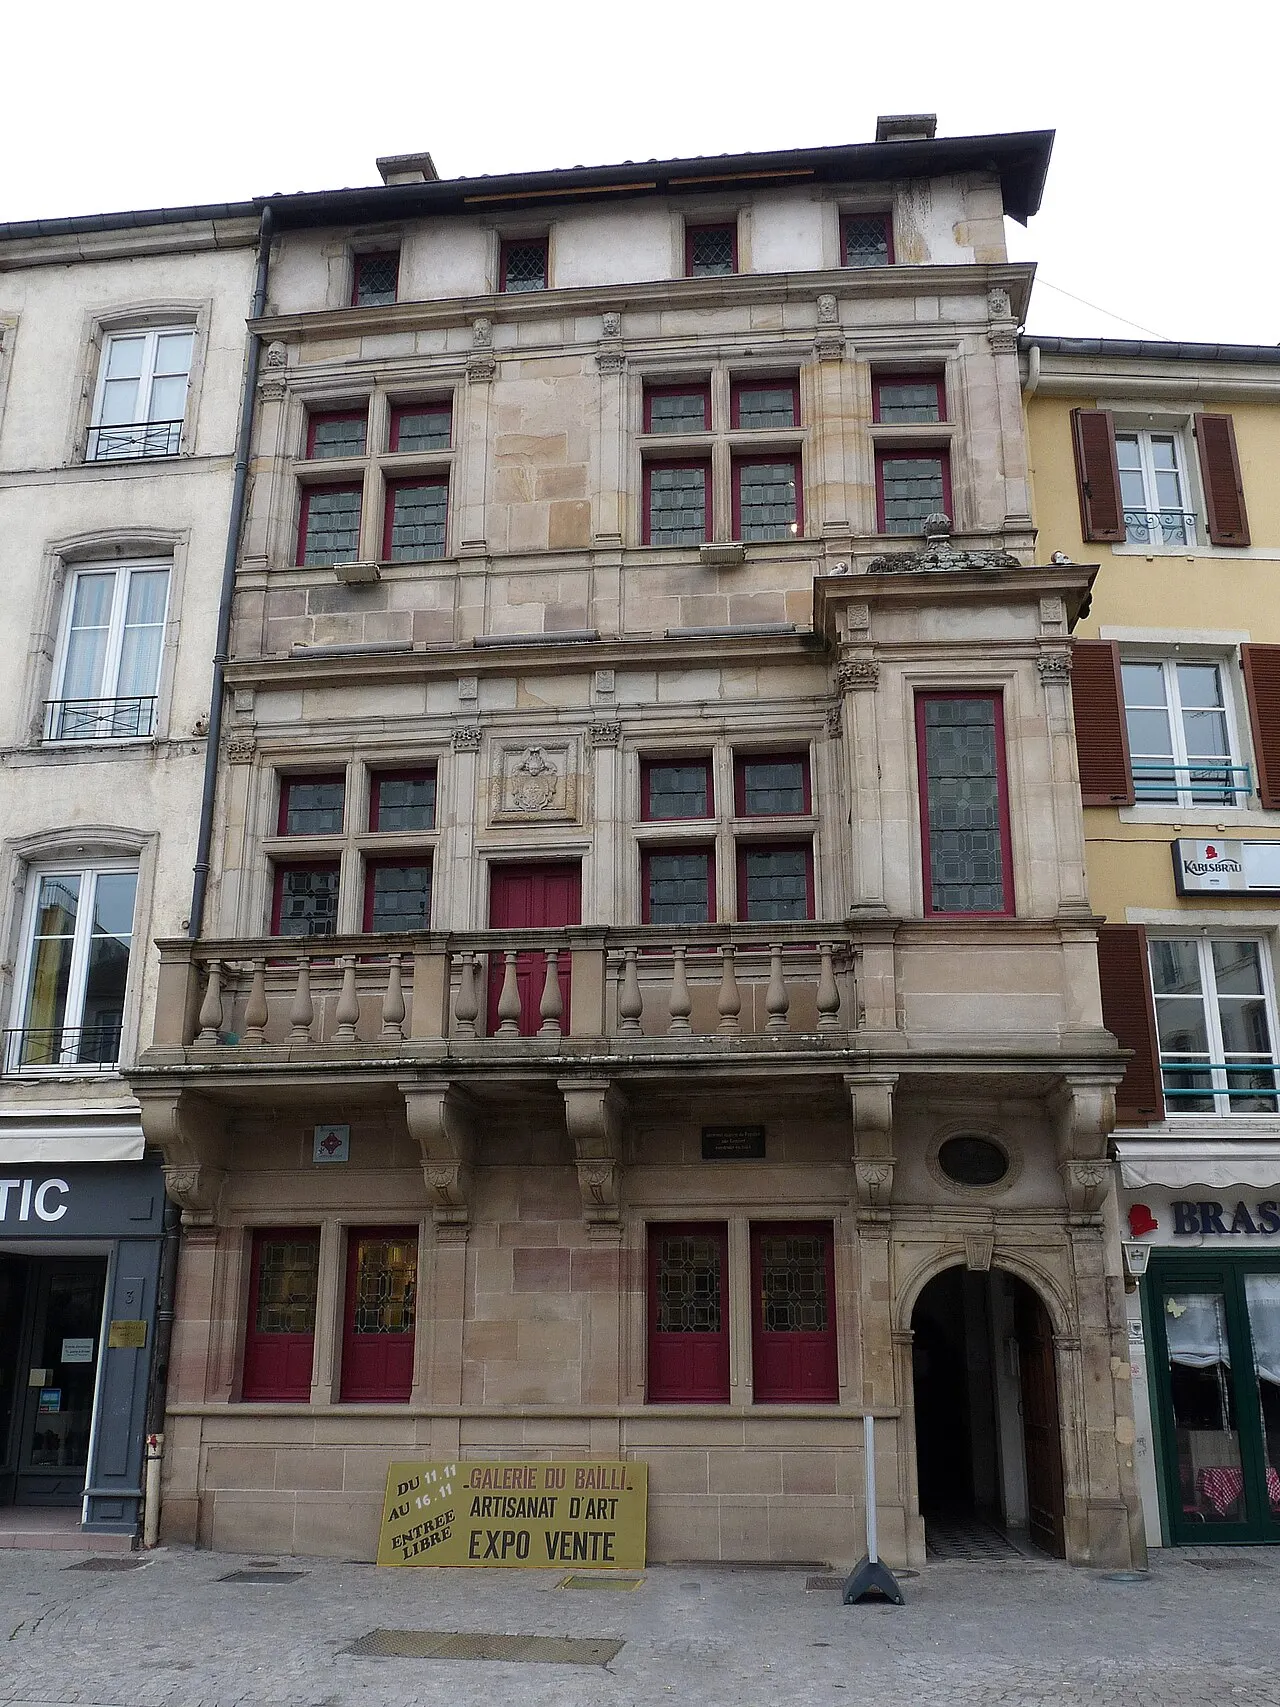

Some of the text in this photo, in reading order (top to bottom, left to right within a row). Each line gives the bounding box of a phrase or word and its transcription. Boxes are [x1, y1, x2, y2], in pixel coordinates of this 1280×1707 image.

[0, 1178, 70, 1221] TIC
[1170, 1200, 1280, 1234] BRAS
[126, 1290, 134, 1304] 3
[397, 1475, 420, 1496] DU
[545, 1468, 566, 1490] DU
[388, 1501, 410, 1522] AU
[469, 1496, 619, 1520] ARTISANAT D'ART
[391, 1509, 456, 1550] ENTREE
[402, 1525, 453, 1561] LIBRE
[468, 1530, 616, 1562] EXPO VENTE
